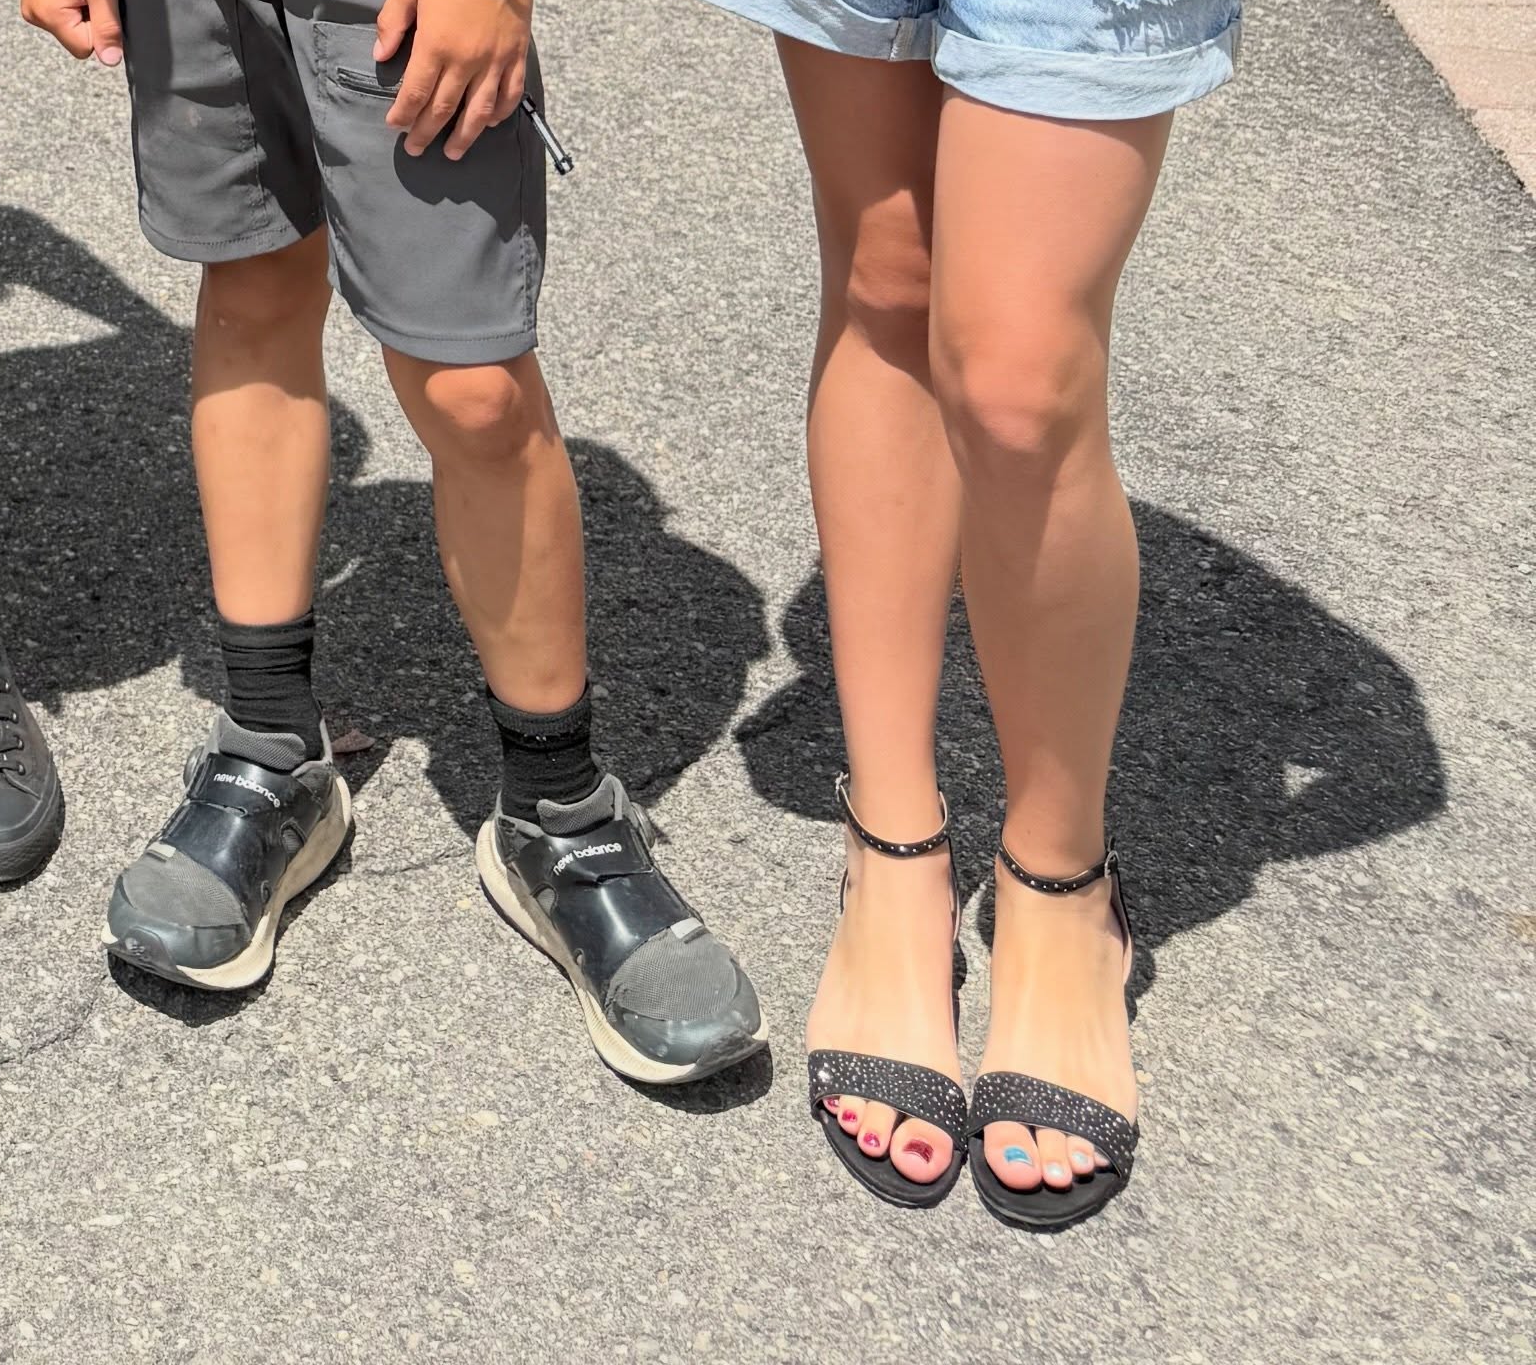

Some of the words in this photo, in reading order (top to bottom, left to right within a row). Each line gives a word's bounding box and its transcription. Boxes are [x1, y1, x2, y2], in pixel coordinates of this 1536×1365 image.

[213, 773, 236, 783] new
[235, 774, 281, 808] balance
[552, 853, 574, 876] new
[573, 842, 622, 858] balance
